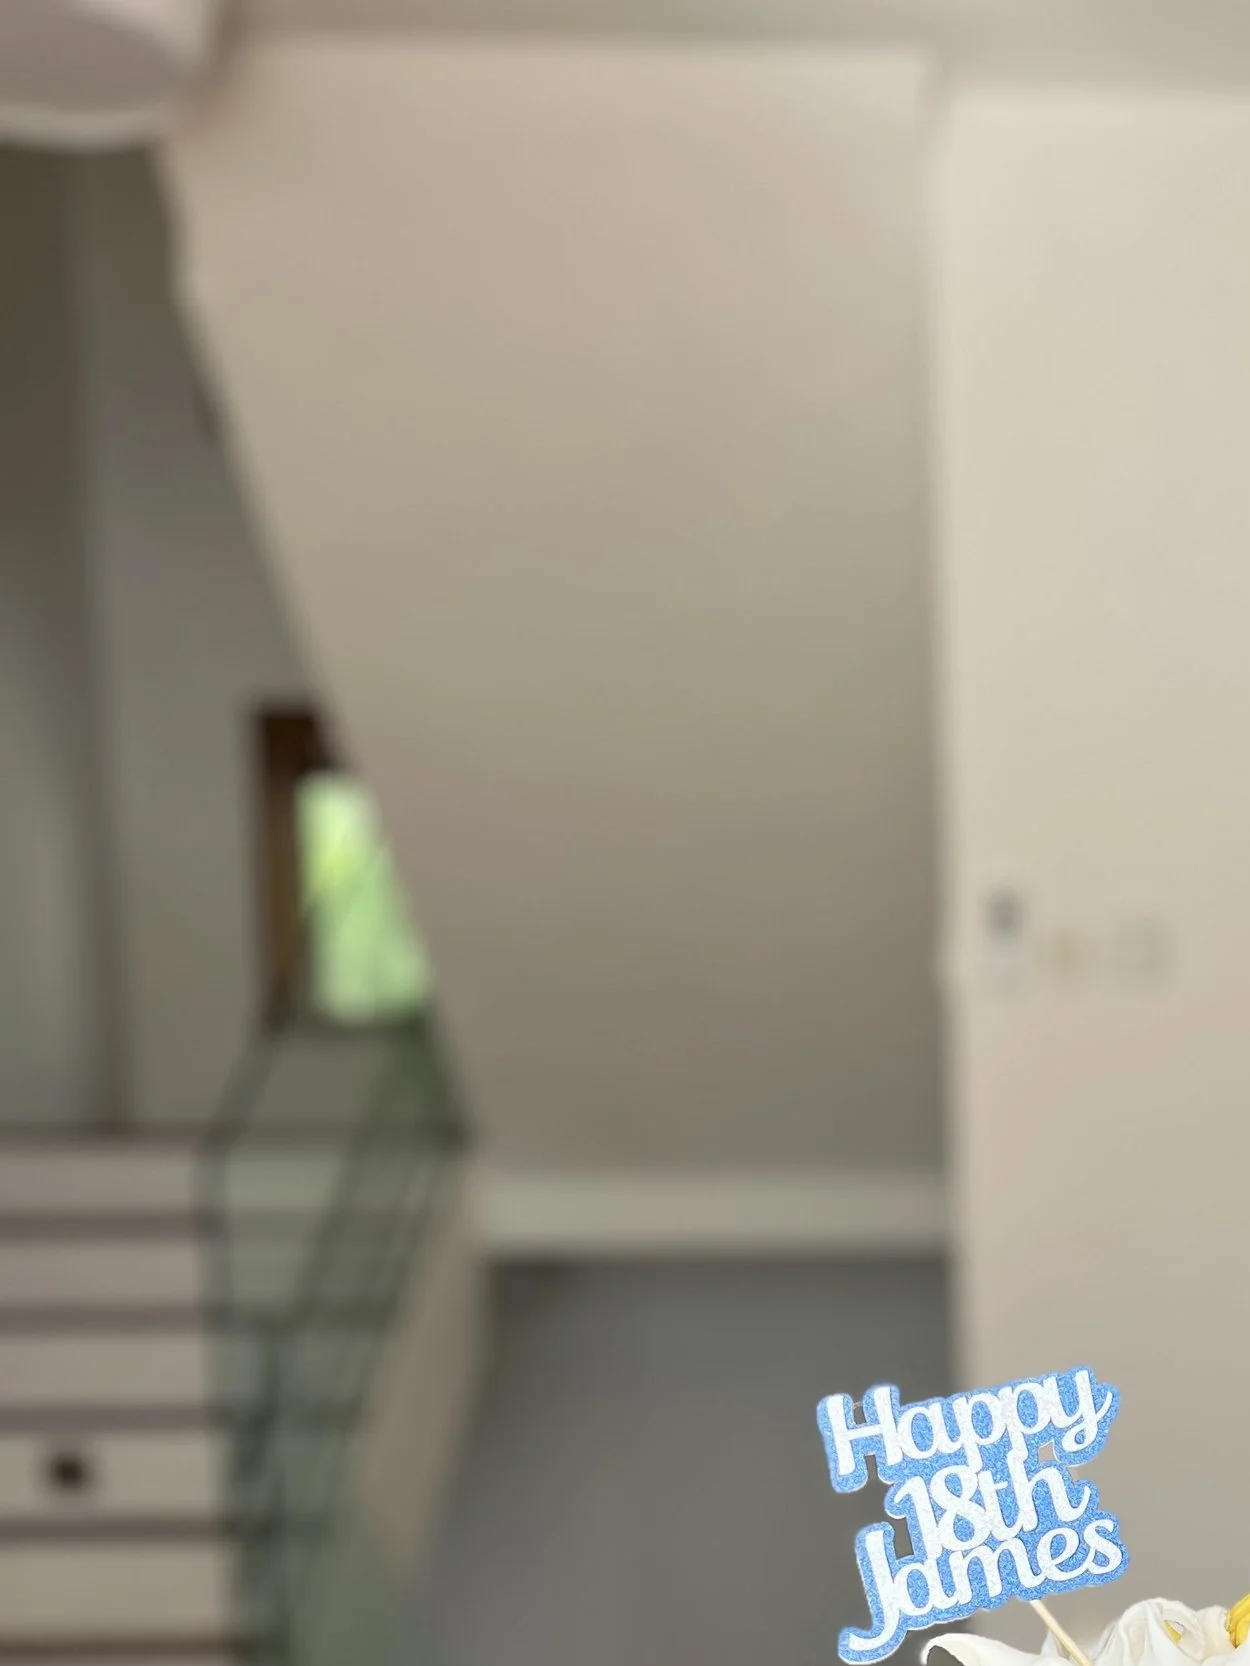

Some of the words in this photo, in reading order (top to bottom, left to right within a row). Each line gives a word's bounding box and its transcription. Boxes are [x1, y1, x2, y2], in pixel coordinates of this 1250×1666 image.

[826, 1370, 1112, 1475] Happy
[894, 1449, 1090, 1557] 18th
[848, 1518, 1122, 1650] James
